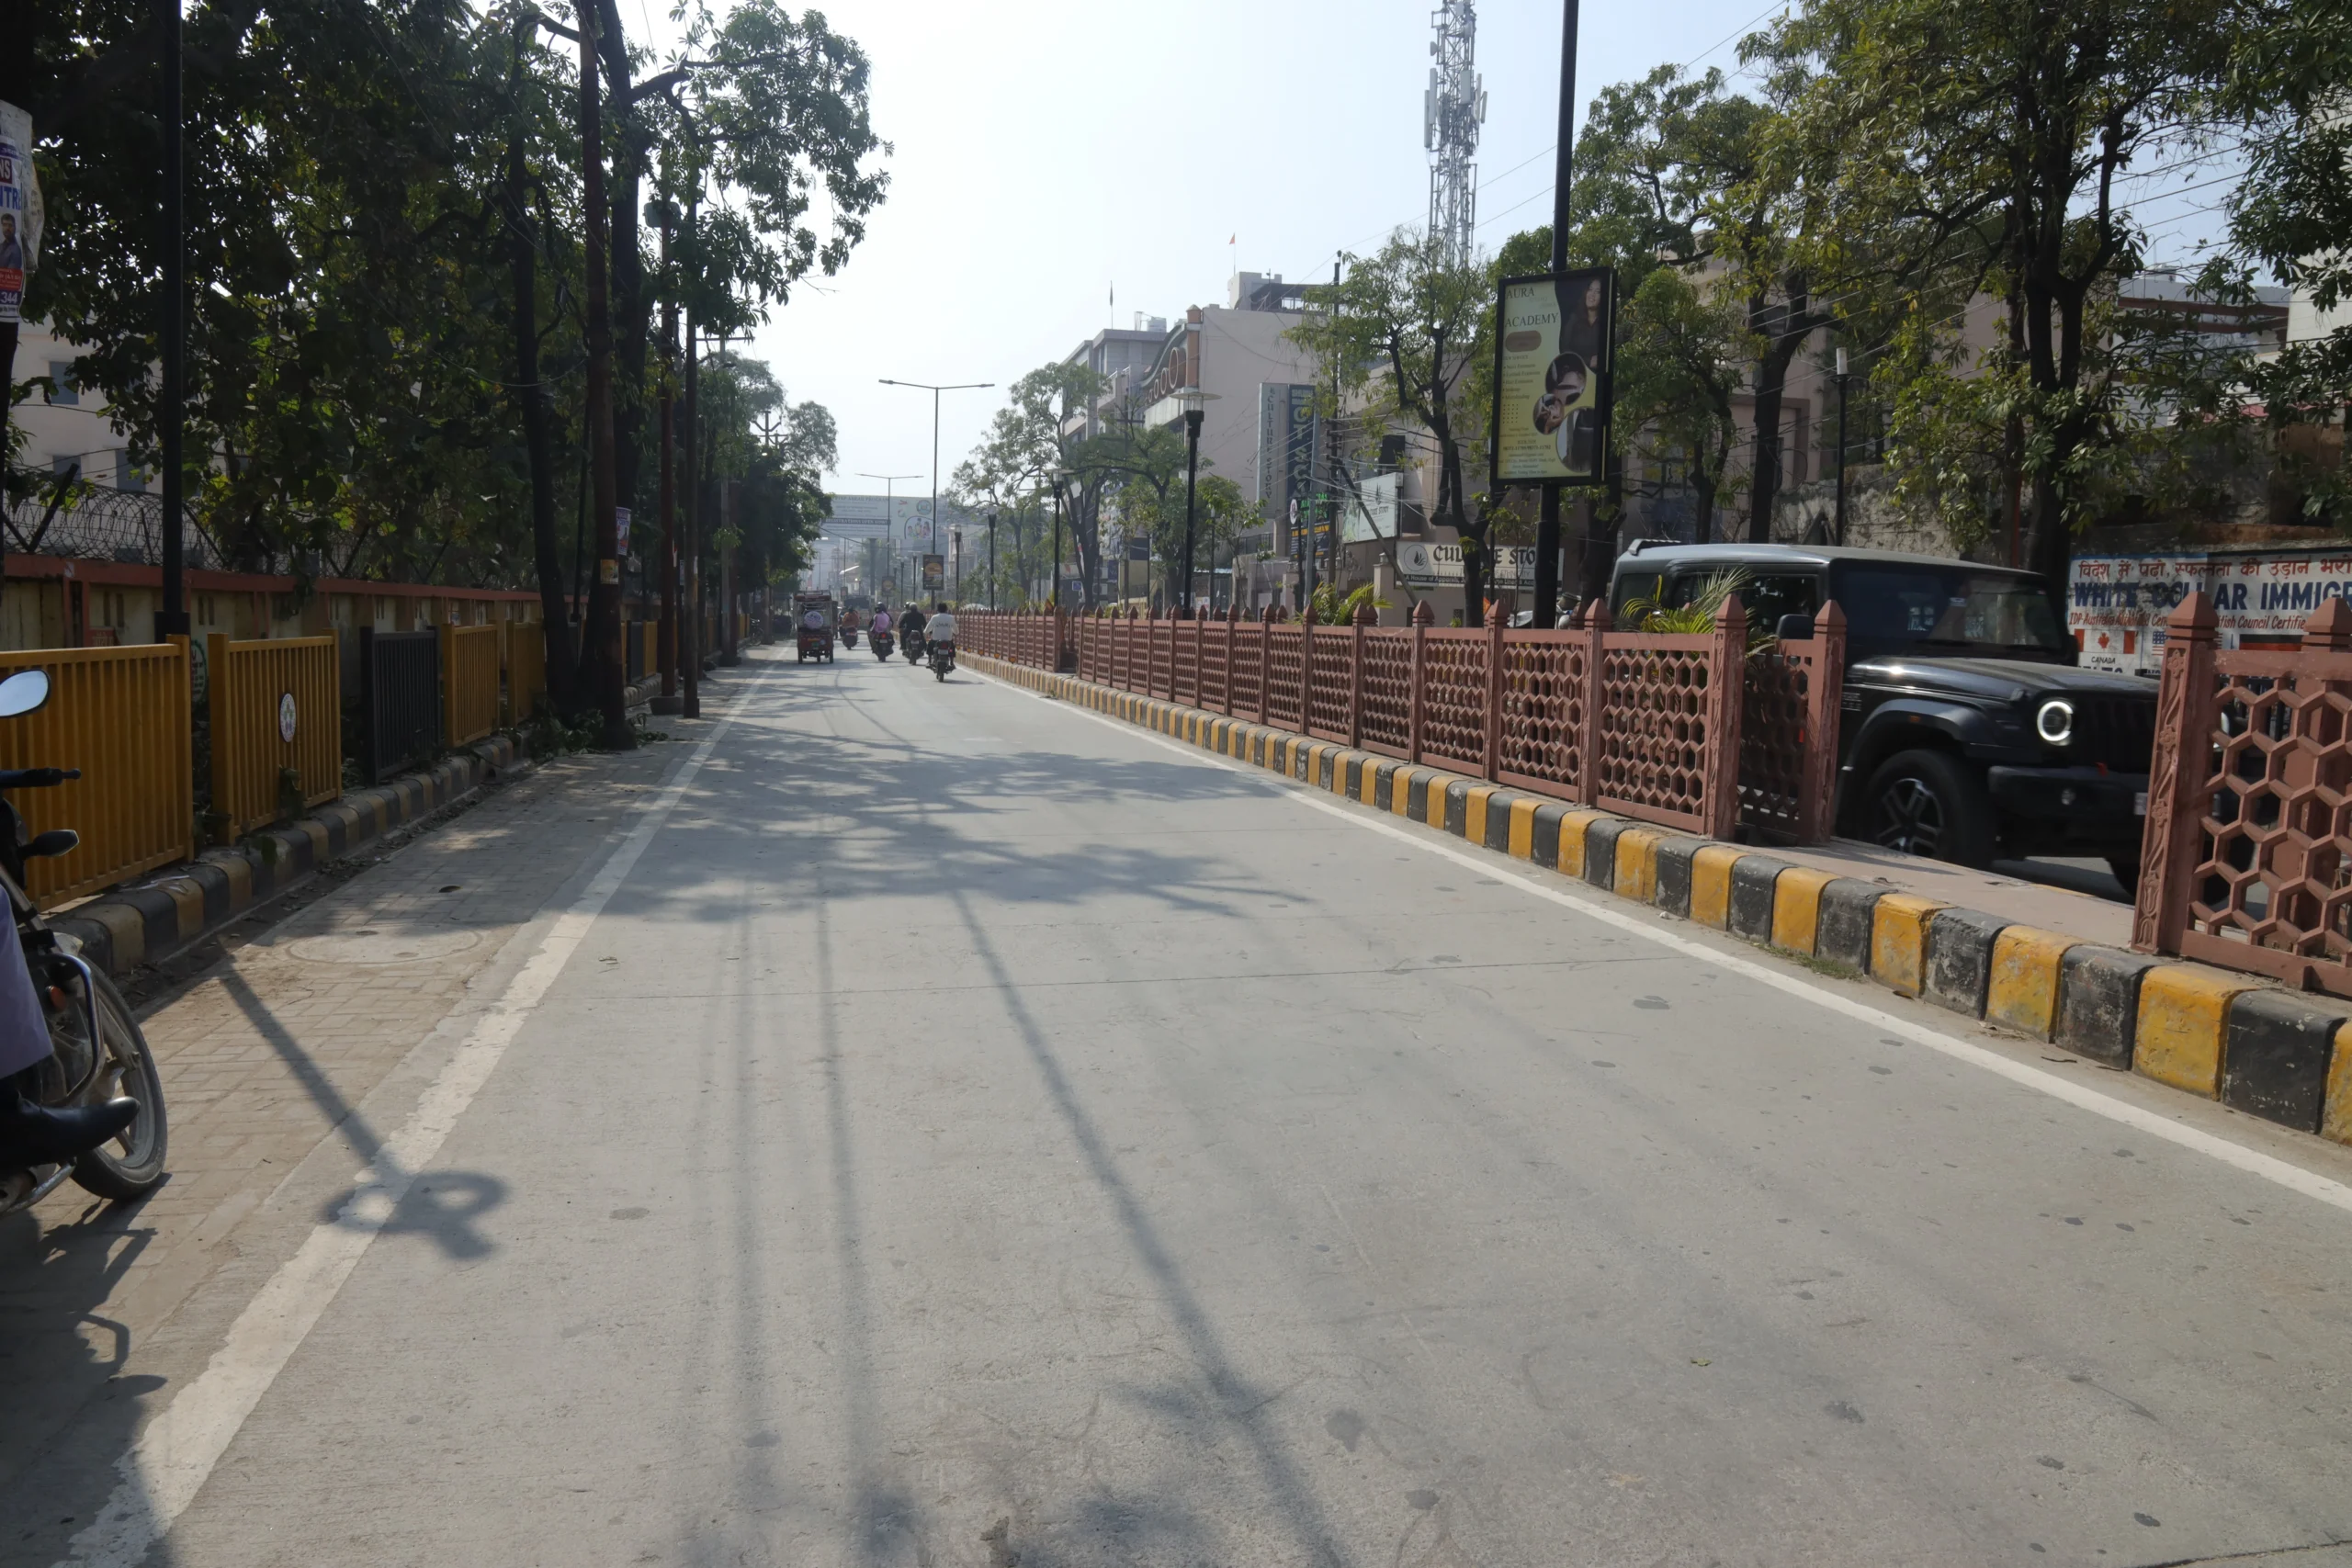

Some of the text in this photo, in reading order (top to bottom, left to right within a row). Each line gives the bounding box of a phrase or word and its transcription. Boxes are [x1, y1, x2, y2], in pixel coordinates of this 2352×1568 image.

[1506, 287, 1534, 299] AURA
[1505, 312, 1559, 328] ACADEMY
[2078, 559, 2110, 579] विदेश
[2075, 582, 2140, 607] WHITE
[2217, 615, 2236, 628] itish
[2238, 615, 2269, 630] Council
[2271, 615, 2305, 629] Certifie
[2091, 655, 2116, 665] CANADA
